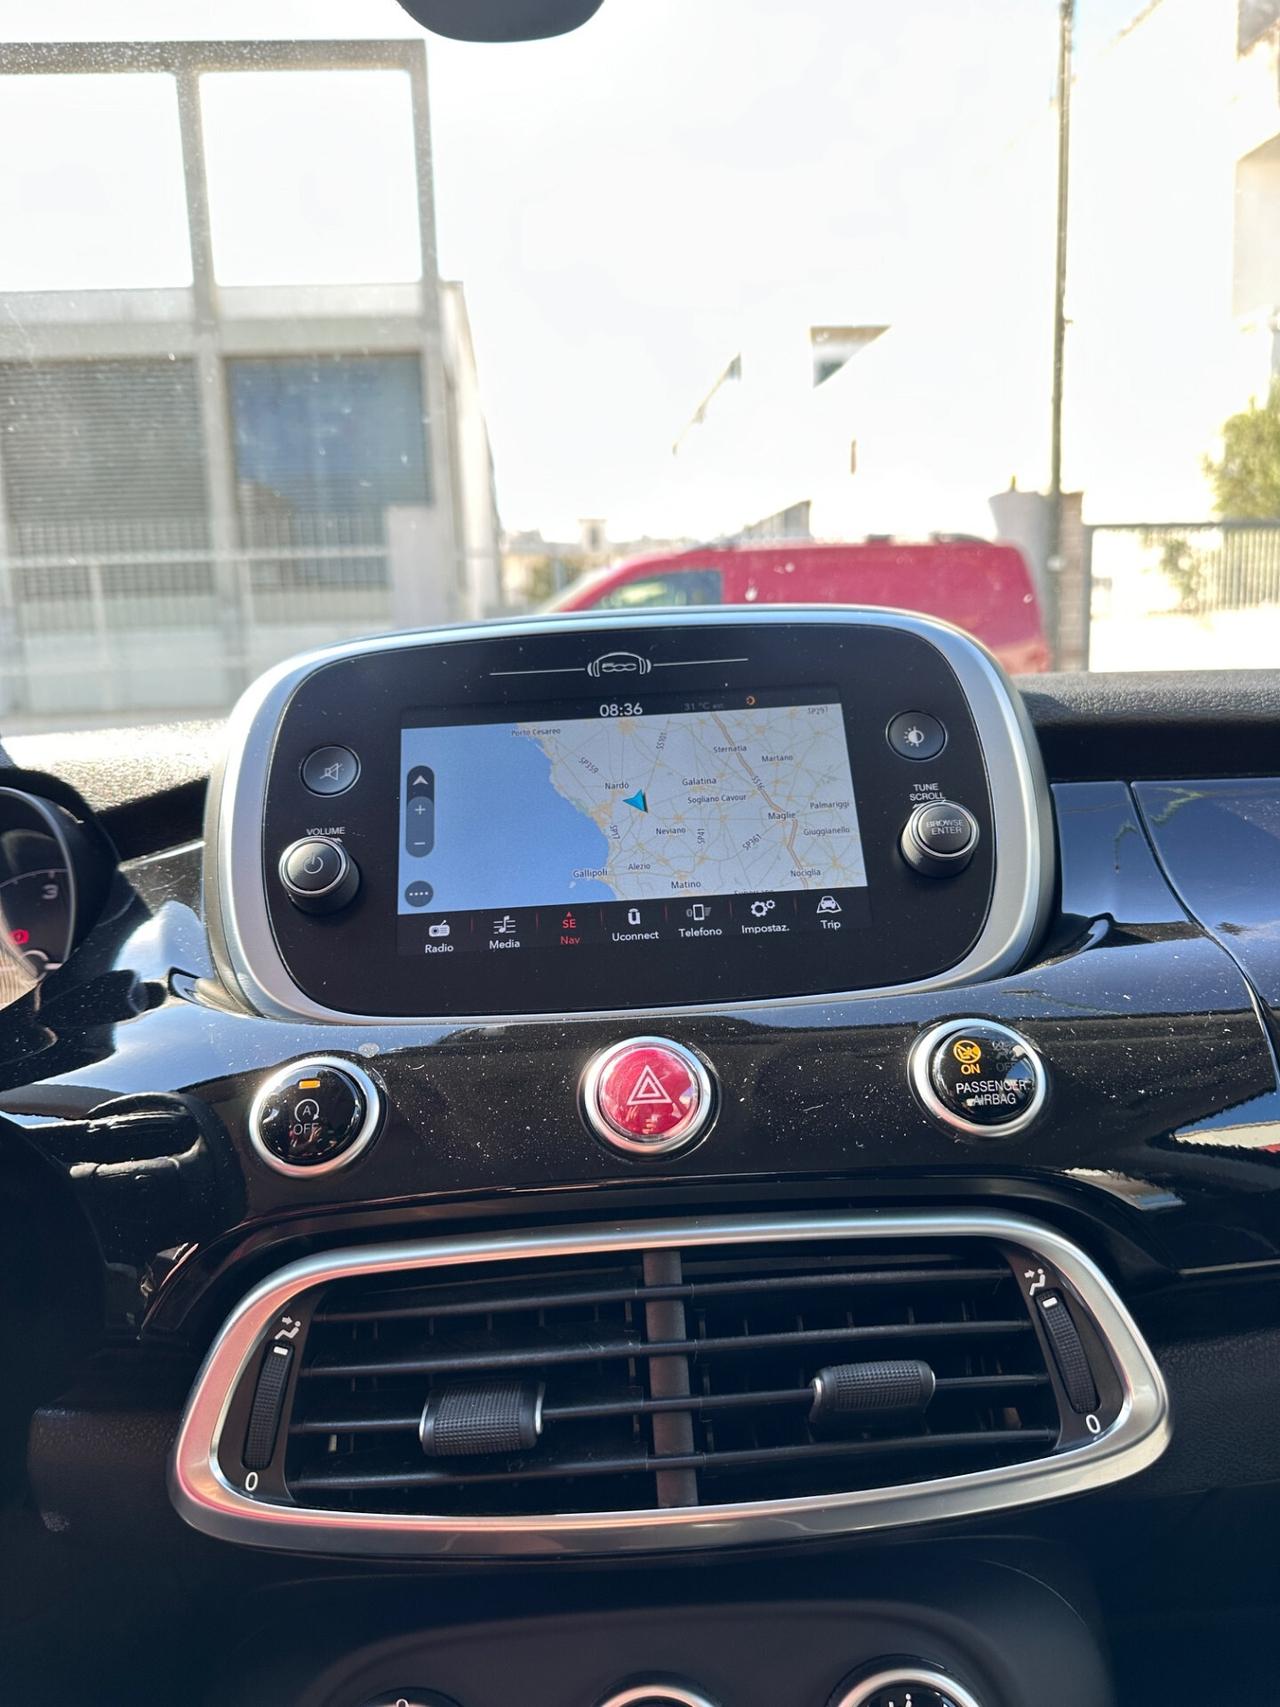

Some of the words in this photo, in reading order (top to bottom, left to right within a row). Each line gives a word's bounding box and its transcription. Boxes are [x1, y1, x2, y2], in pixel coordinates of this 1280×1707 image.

[602, 663, 637, 672] 500
[600, 702, 643, 717] 08:36
[532, 728, 561, 736] Cesareo
[713, 745, 747, 753] Sternatia
[761, 754, 794, 763] Martano
[682, 777, 717, 786] Galatina
[912, 783, 940, 792] TUNE
[687, 796, 720, 805] Sogliano
[721, 794, 747, 802] Cavour
[909, 792, 946, 801] SCROLL
[810, 801, 850, 811] Palmariggi
[768, 810, 796, 821] Maglie
[926, 820, 964, 828] BROWSE
[306, 827, 346, 836] VOLUME
[655, 827, 687, 835] Neviano
[803, 827, 850, 837] Giuggianello
[931, 827, 962, 836] ENTER
[628, 862, 651, 870] Alezio
[572, 868, 608, 880] Gallipoli
[790, 869, 821, 879] Nociglia
[671, 880, 702, 889] Matino
[43, 884, 59, 900] 3
[562, 919, 577, 928] SE
[820, 919, 842, 931] Trip
[678, 926, 722, 938] Telefono
[741, 923, 790, 935] Impostaz.
[560, 935, 581, 945] Nav
[612, 930, 660, 942] Uconnect
[424, 944, 454, 954] Radio
[489, 939, 521, 950] Media
[961, 1063, 981, 1075] ON
[955, 1080, 1026, 1094] PASSENGER
[972, 1093, 1017, 1106] AIRBAG
[293, 1122, 320, 1136] OFF
[1085, 1414, 1101, 1434] 0
[245, 1471, 259, 1491] 0
